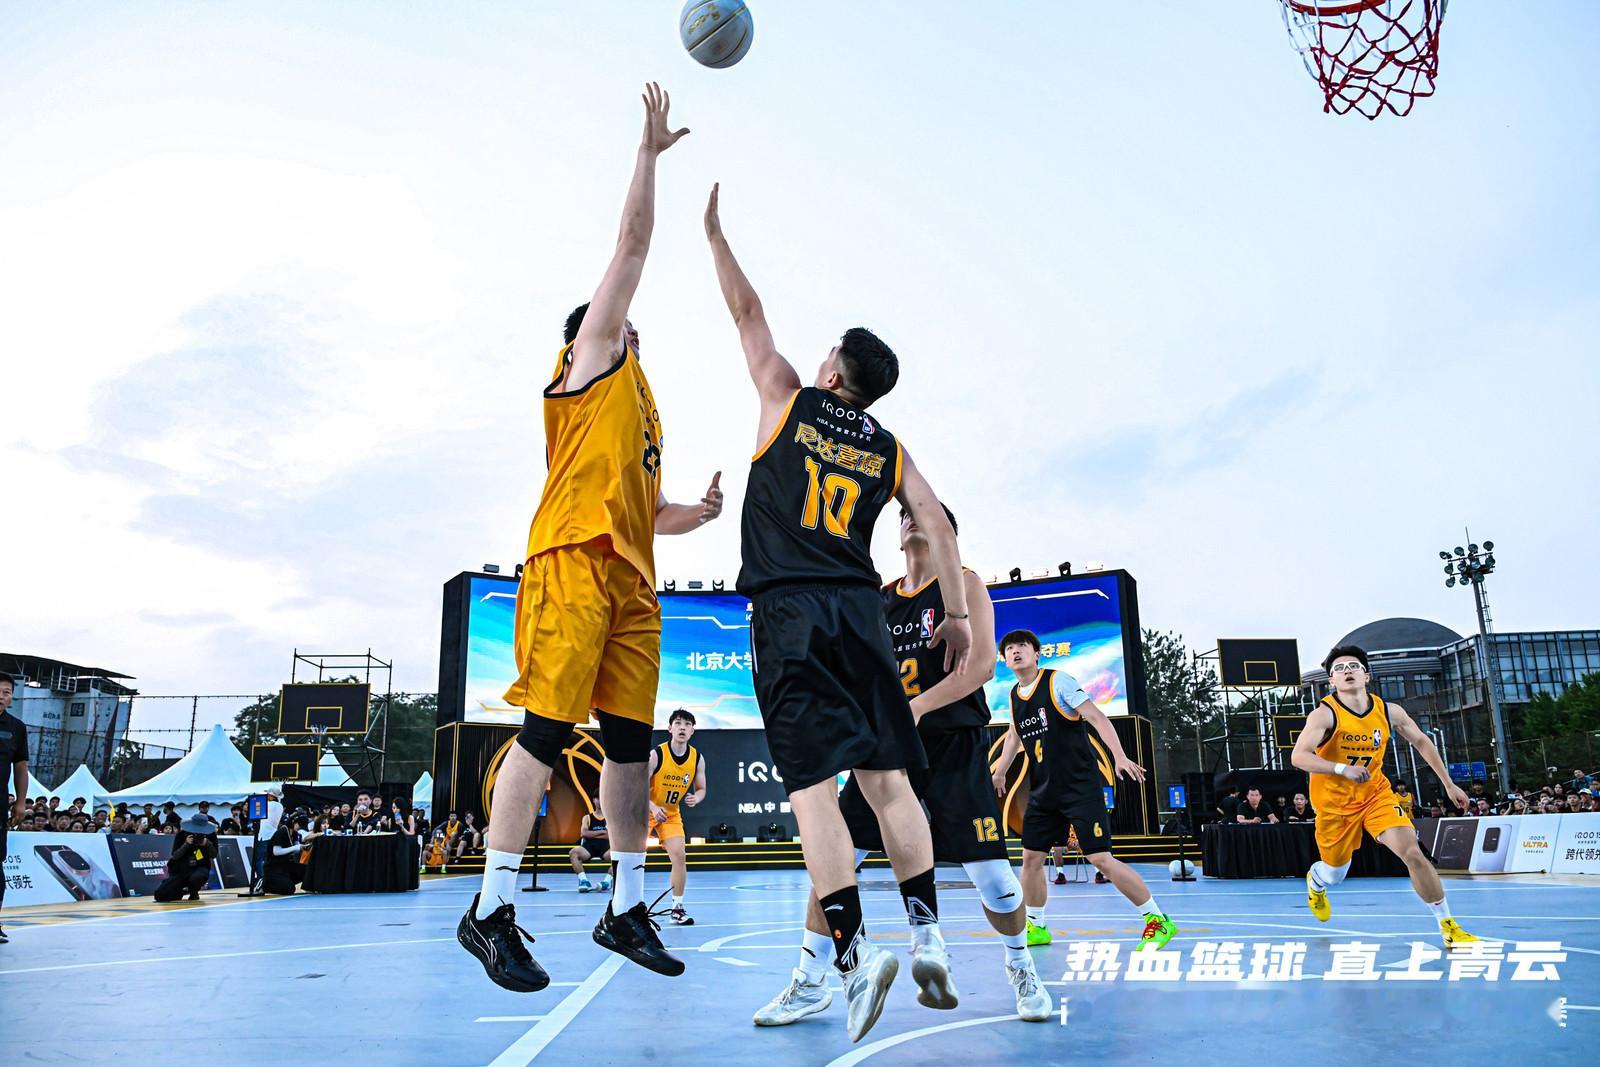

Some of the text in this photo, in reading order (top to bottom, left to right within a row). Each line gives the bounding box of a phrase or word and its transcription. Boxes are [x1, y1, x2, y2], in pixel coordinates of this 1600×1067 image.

[821, 399, 857, 421] iQOO
[800, 455, 862, 539] 10
[665, 790, 680, 805] 18
[738, 802, 763, 814] NBA
[972, 816, 1000, 843] 12
[1093, 821, 1103, 838] 6
[1523, 841, 1549, 849] ULTRA
